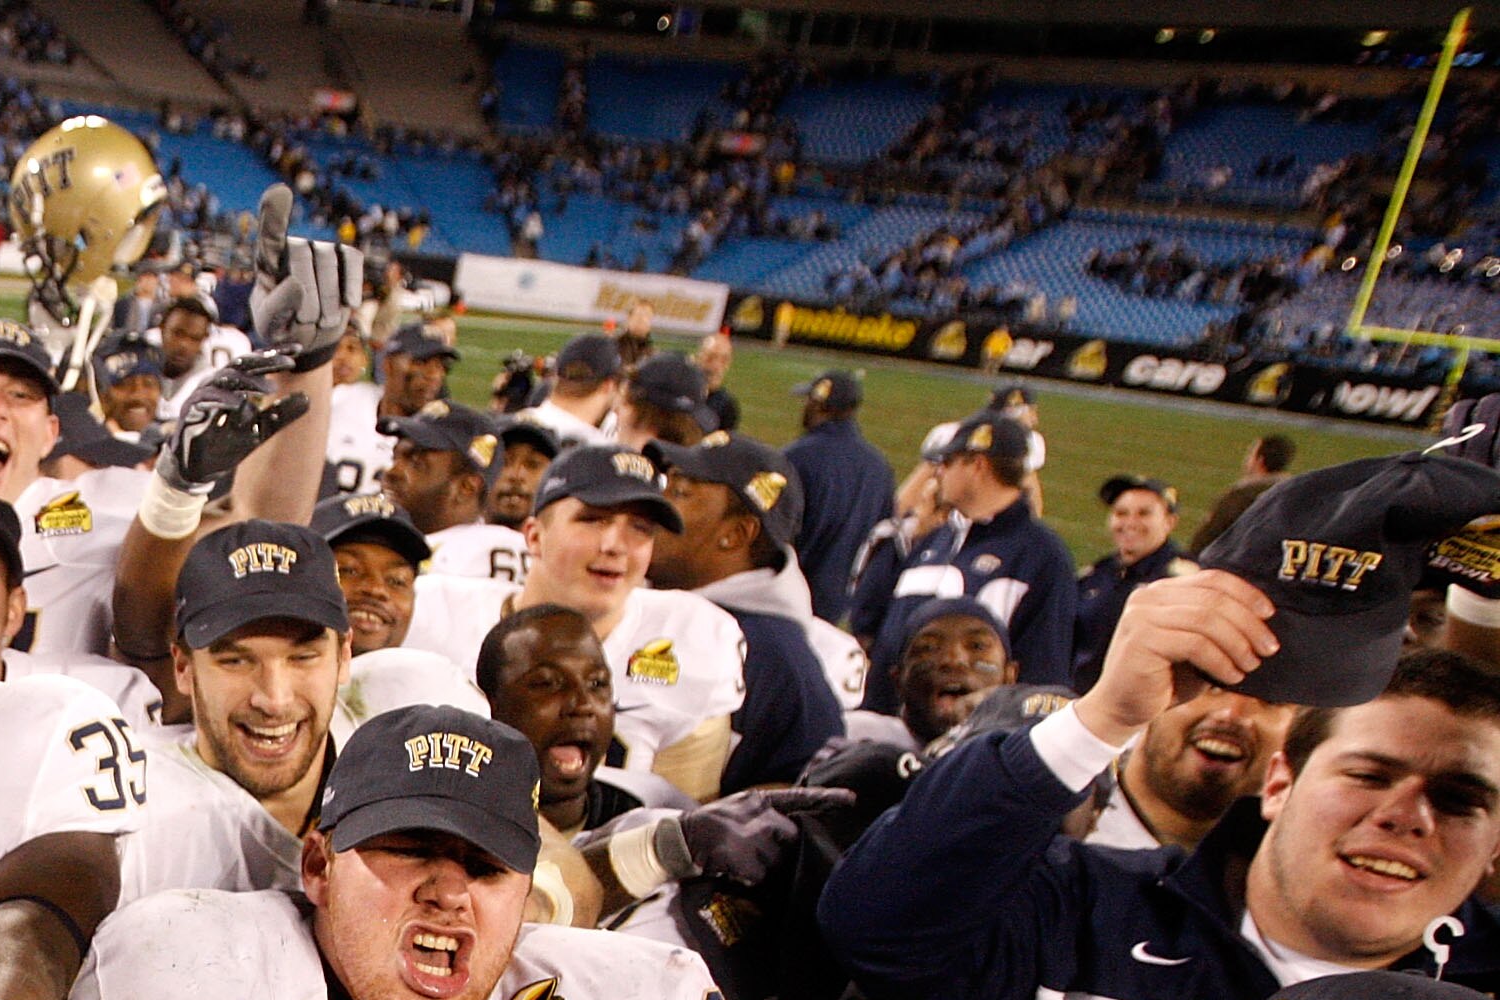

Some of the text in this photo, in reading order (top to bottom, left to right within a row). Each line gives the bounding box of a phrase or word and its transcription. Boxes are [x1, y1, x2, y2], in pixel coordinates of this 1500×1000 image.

[1122, 354, 1228, 395] care
[228, 542, 297, 580] PITT
[1278, 539, 1383, 592] PITT
[67, 717, 147, 811] 35
[404, 731, 493, 778] PITT
